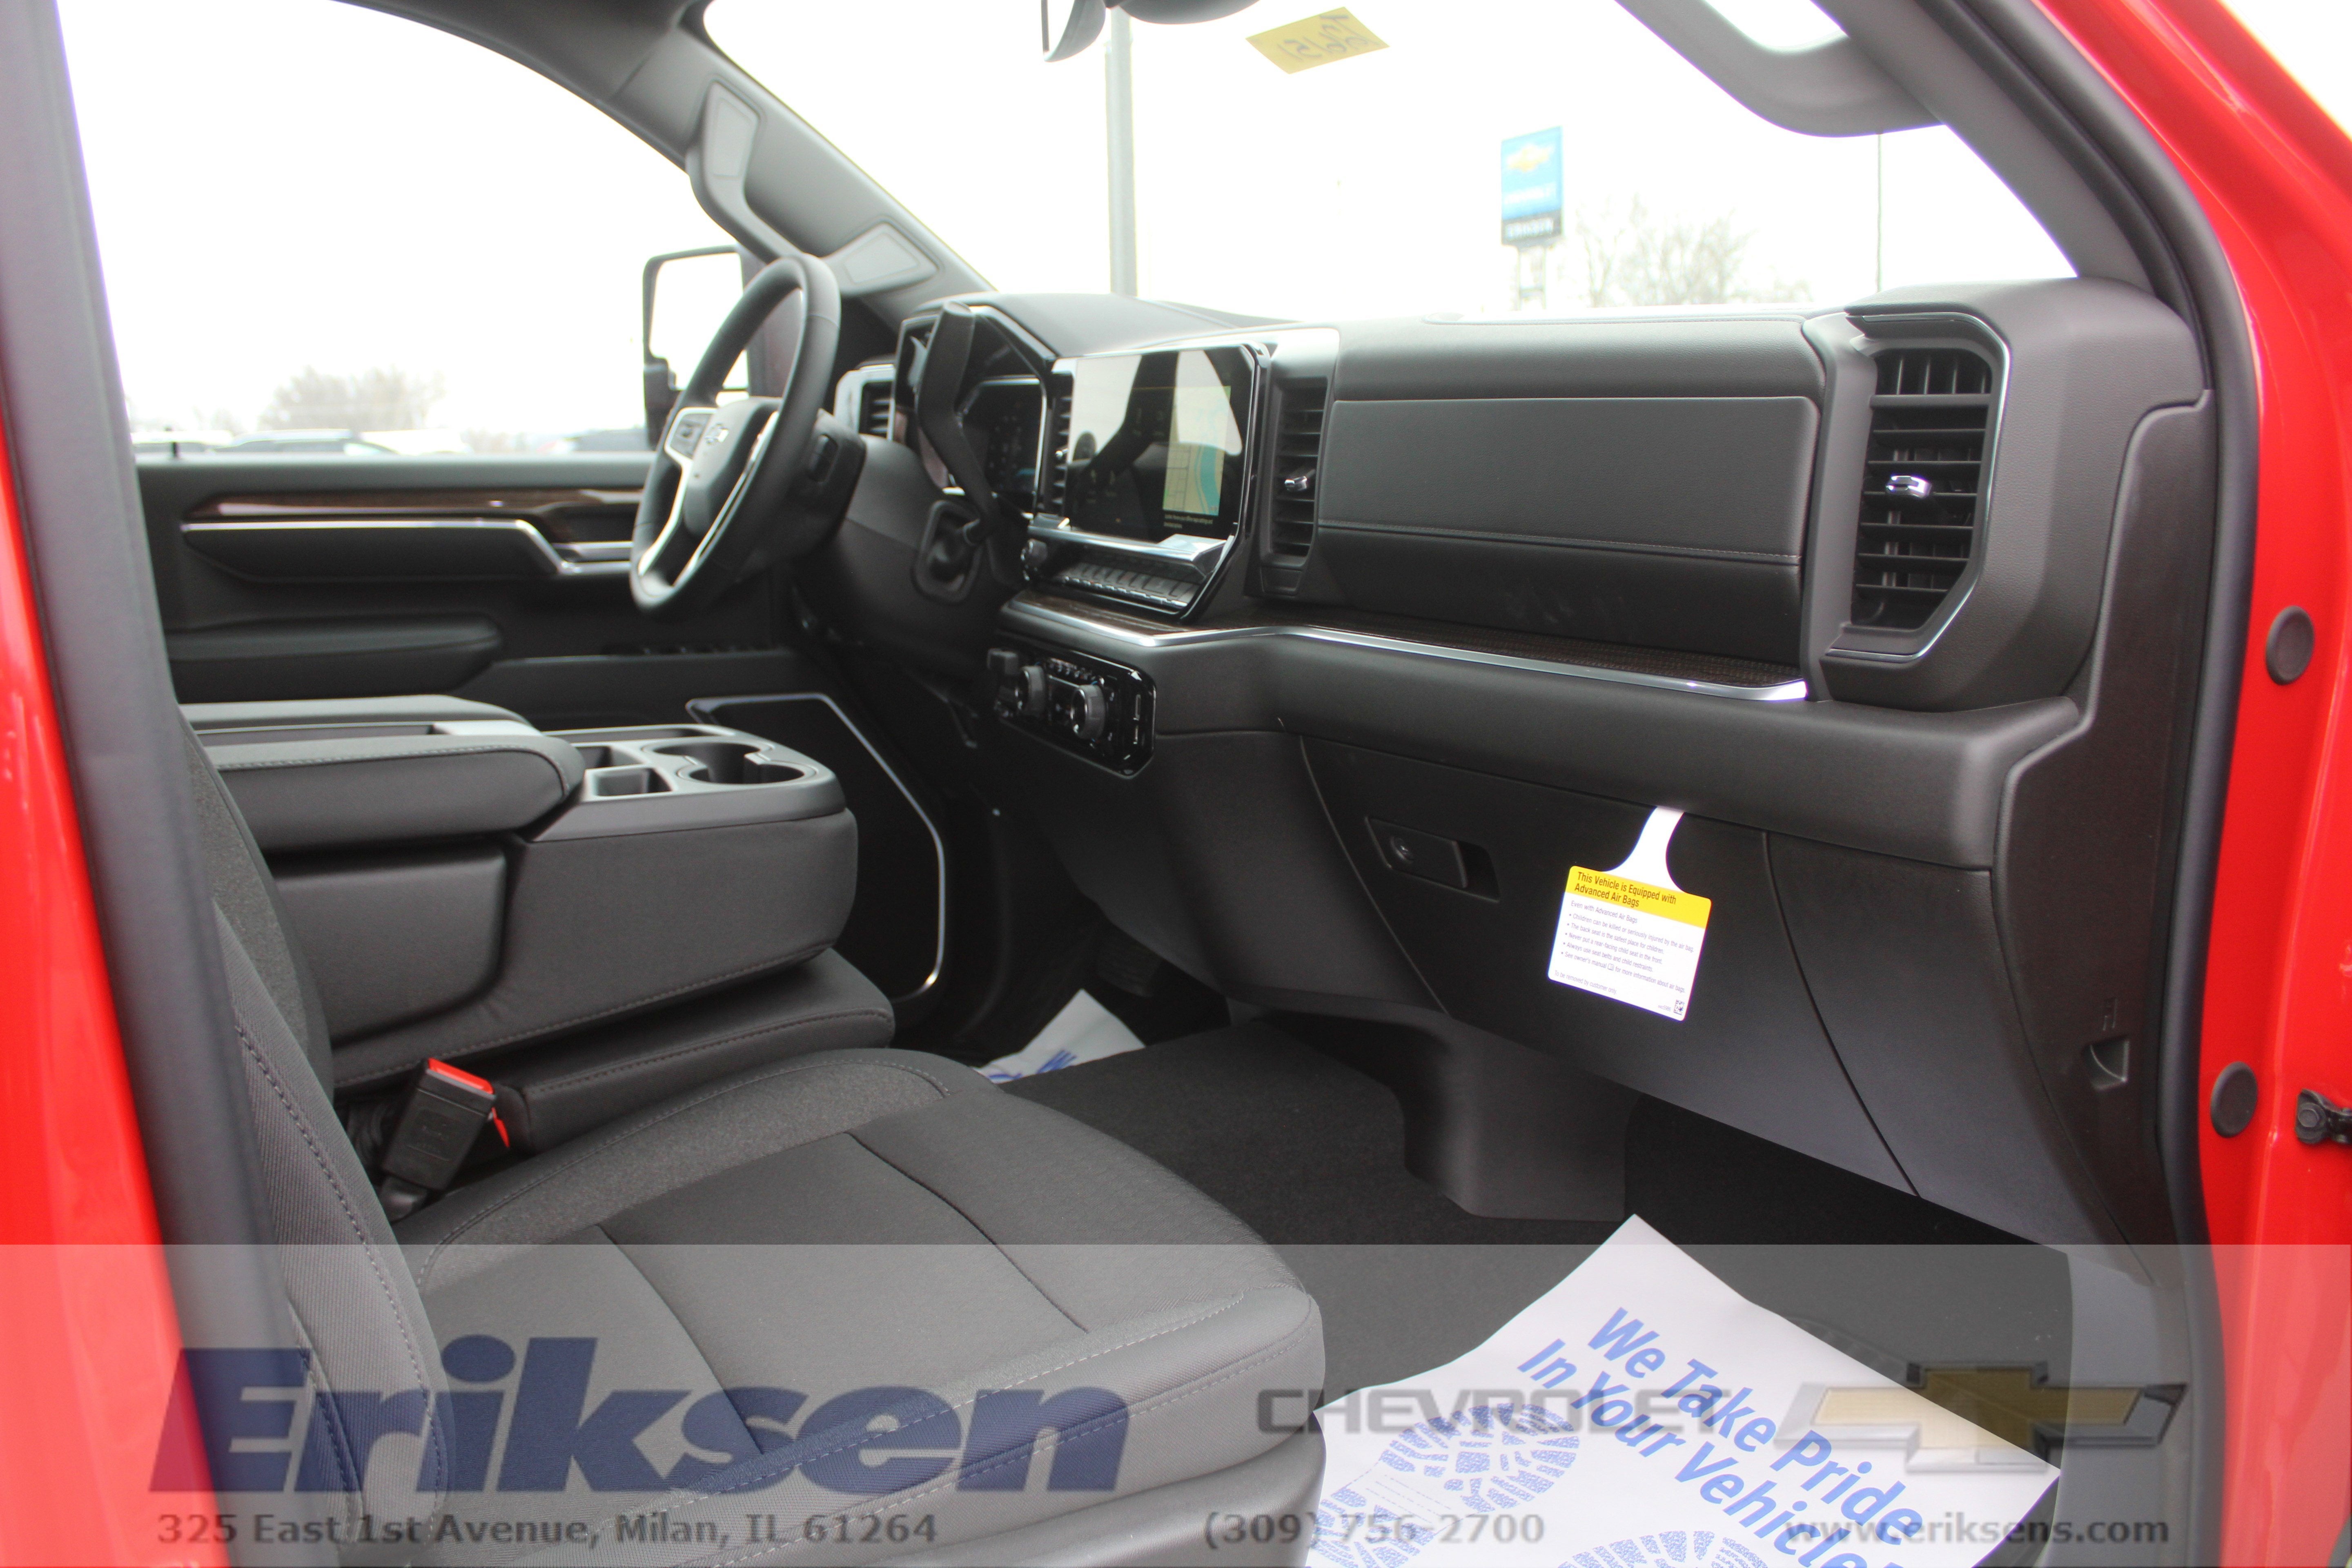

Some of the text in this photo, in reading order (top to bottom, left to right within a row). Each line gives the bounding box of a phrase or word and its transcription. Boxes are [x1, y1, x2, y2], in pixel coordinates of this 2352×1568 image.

[1574, 883, 1639, 907] Advanced Air Bags
[1578, 871, 1676, 904] This Vehicle is Equipped with
[1595, 907, 1618, 918] Advanced
[1626, 915, 1637, 923] Bags
[1569, 932, 1582, 940] Never
[1573, 913, 1592, 923] Children
[1608, 923, 1621, 931] killed
[1627, 929, 1647, 940] seriously
[1648, 934, 1664, 943] injured
[1566, 942, 1583, 951] Always
[1591, 960, 1607, 969] manual
[1633, 972, 1656, 983] information
[1588, 1307, 1923, 1545] We Take Pride
[1517, 1339, 1904, 1568] In Your Vehicl
